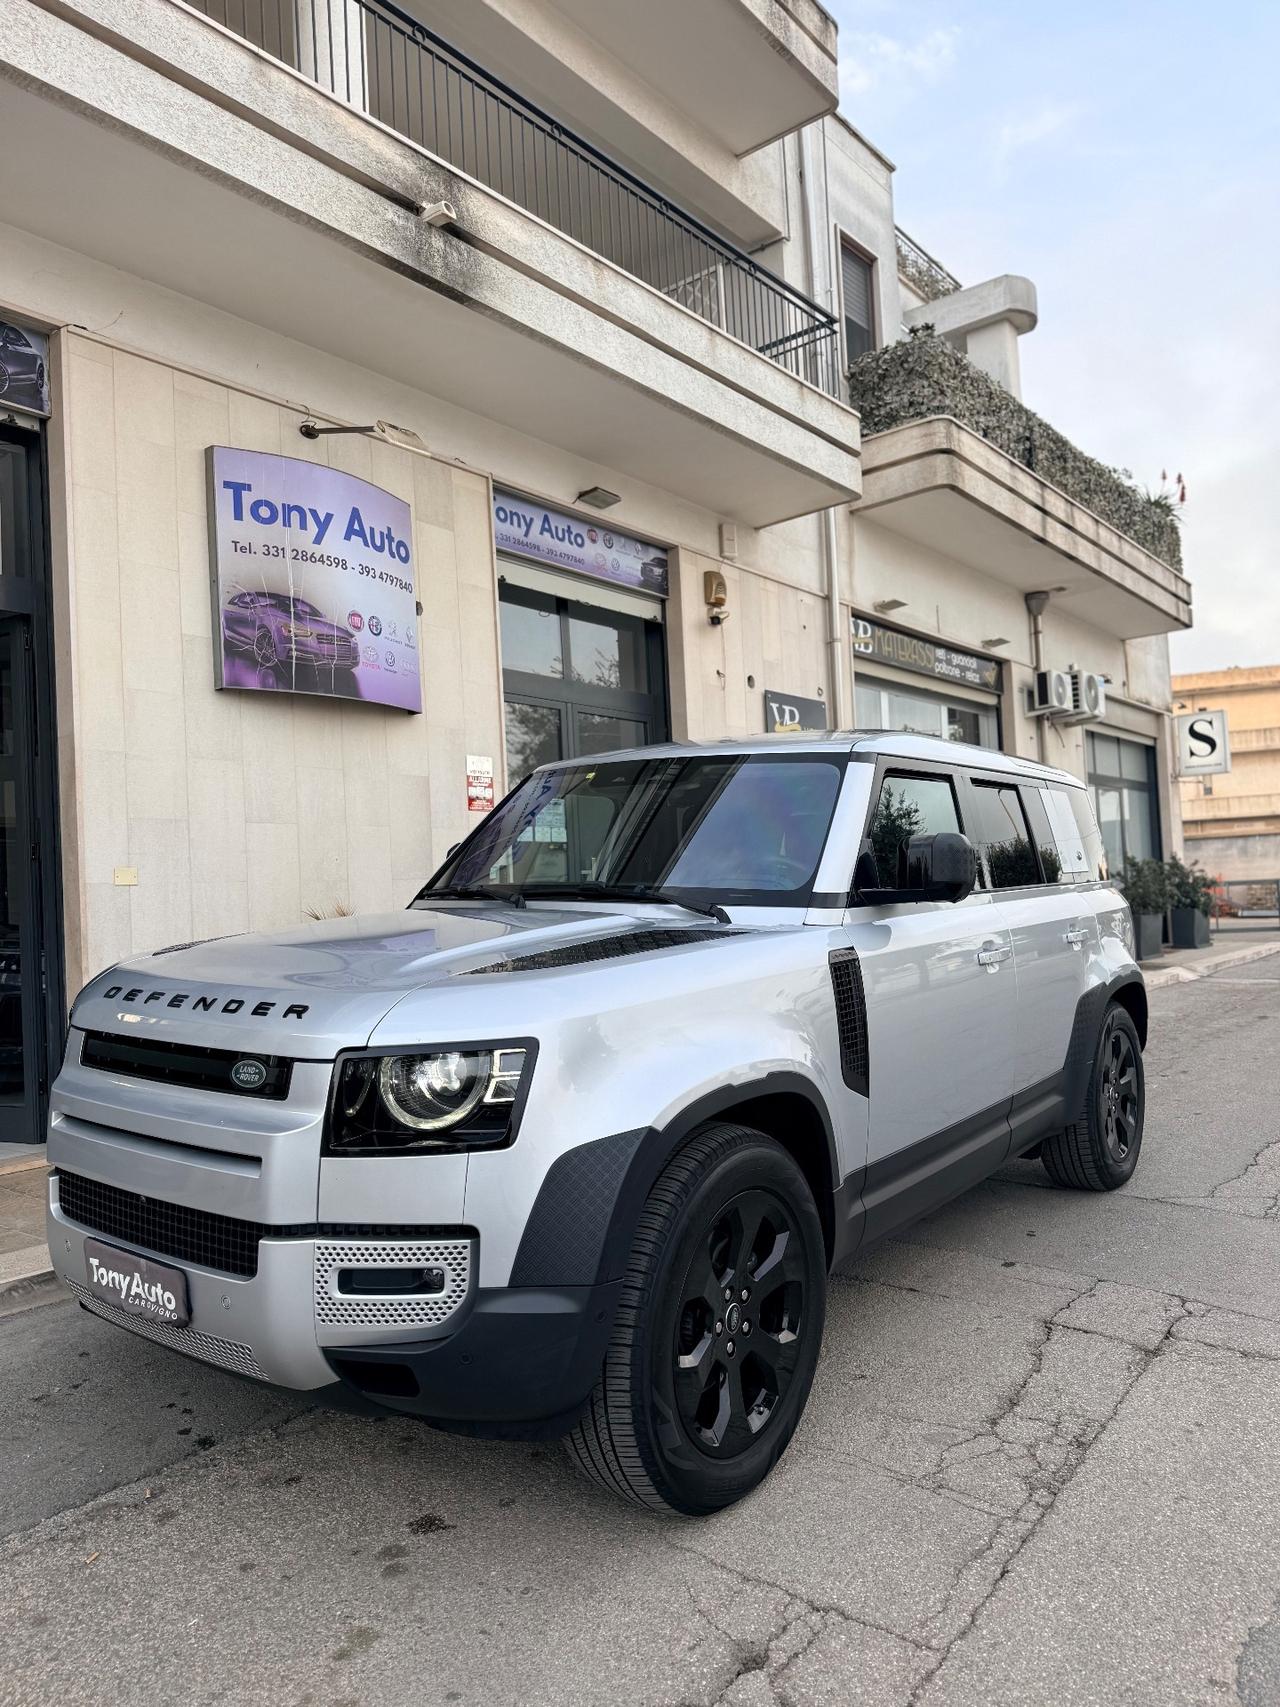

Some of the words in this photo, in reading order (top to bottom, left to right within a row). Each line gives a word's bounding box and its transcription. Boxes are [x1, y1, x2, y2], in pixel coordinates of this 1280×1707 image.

[223, 480, 334, 545] Tony
[343, 506, 410, 565] Auto
[494, 496, 534, 538] ony
[539, 513, 585, 548] Auto
[231, 540, 257, 555] Tel.
[262, 544, 286, 559] 331
[291, 548, 348, 571] 2864598
[358, 563, 377, 579] 393
[378, 571, 413, 594] 4797840
[875, 627, 936, 669] MATERASSI
[1188, 718, 1217, 758] S
[103, 986, 310, 1020] DEFENDER
[239, 1065, 256, 1074] LAND
[239, 1073, 260, 1082] ROVER
[128, 1296, 178, 1320] CAROVIGNO
